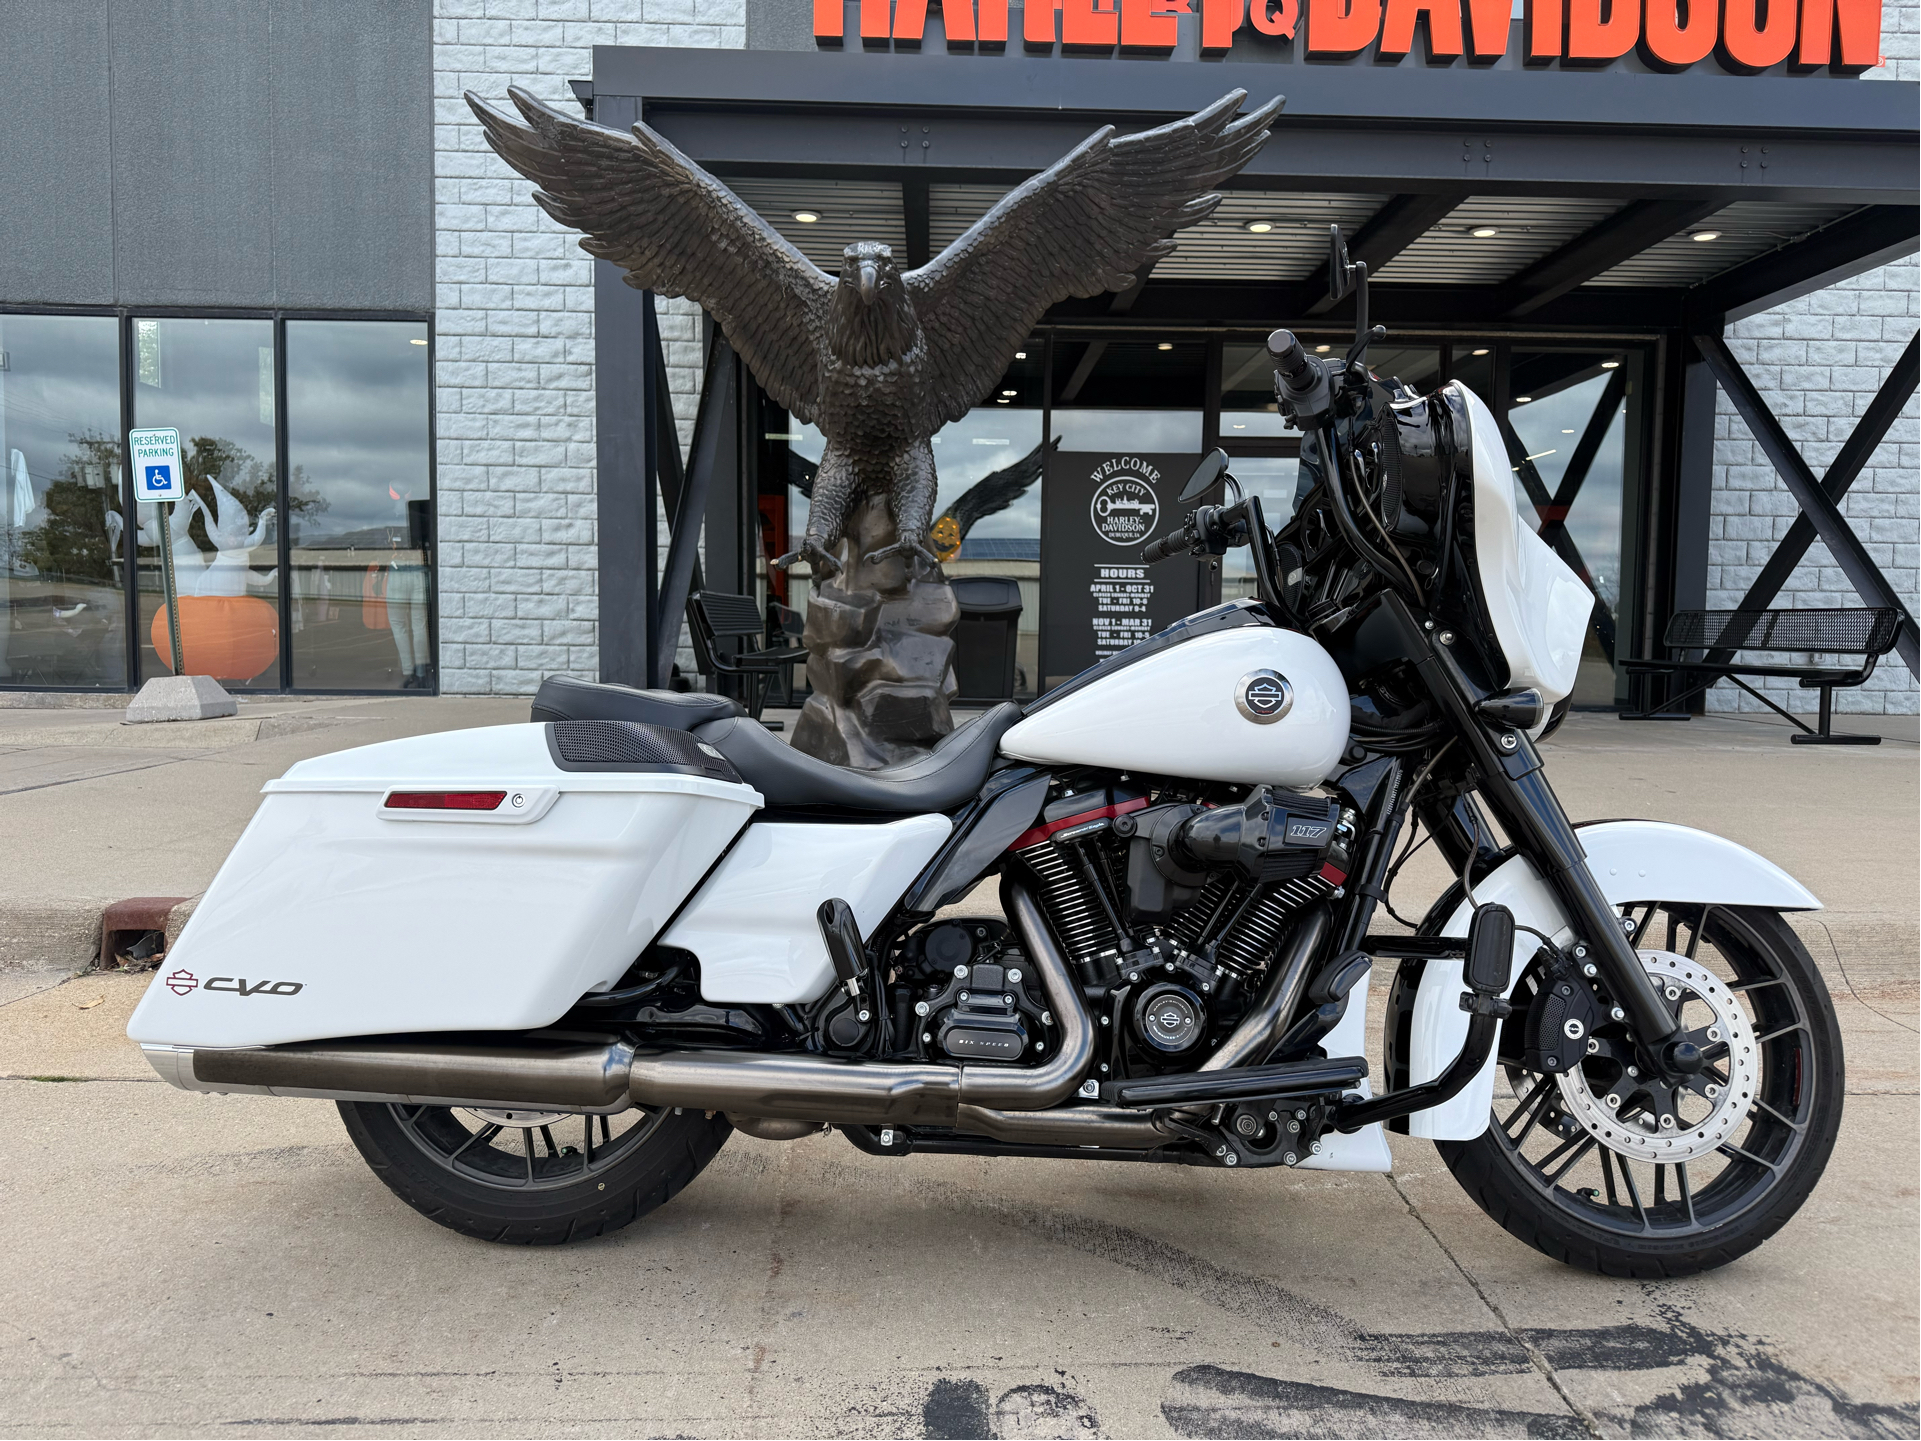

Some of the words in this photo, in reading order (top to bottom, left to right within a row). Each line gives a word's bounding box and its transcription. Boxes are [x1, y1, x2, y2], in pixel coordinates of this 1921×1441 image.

[134, 435, 175, 446] RESERVED
[138, 448, 174, 458] PARKING
[1090, 457, 1160, 484] WELCOME
[1106, 484, 1124, 496] KEY
[1126, 484, 1146, 496] CITY
[1101, 569, 1145, 578] HOURS
[1090, 584, 1114, 592] APRIL
[1126, 585, 1143, 593] OCT
[1144, 585, 1154, 593] 31
[1092, 618, 1110, 626] NOV
[1111, 618, 1116, 626] 1
[1122, 618, 1141, 626] MAR
[1141, 619, 1152, 627] 31
[1290, 825, 1327, 839] 117
[203, 977, 304, 997] CVO
